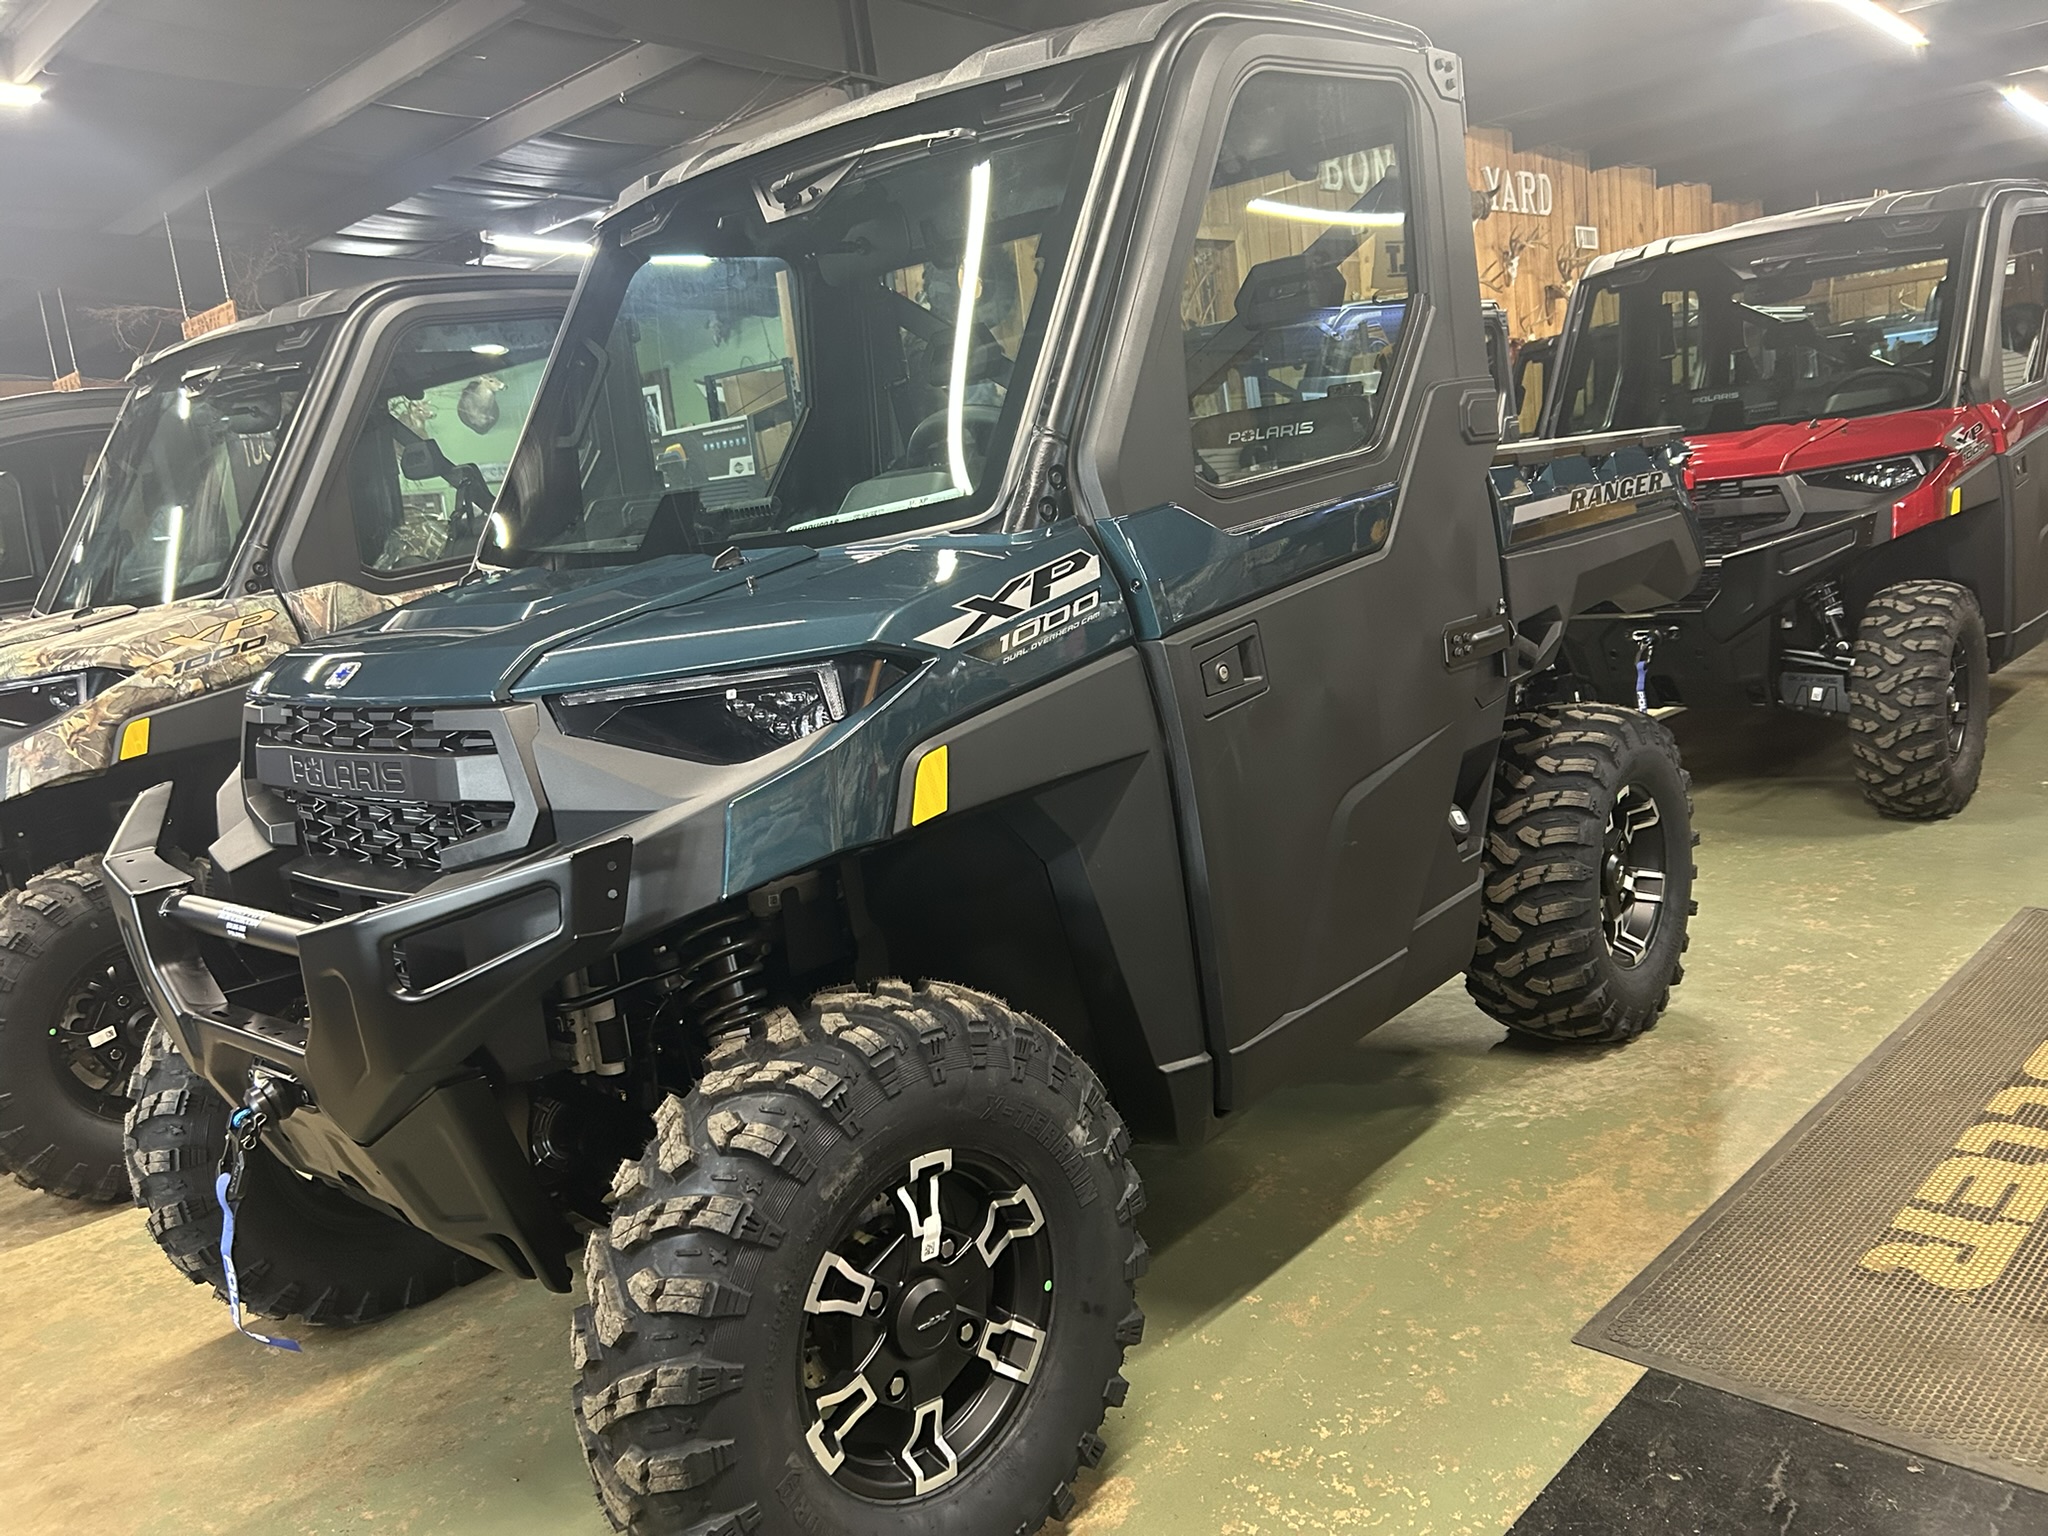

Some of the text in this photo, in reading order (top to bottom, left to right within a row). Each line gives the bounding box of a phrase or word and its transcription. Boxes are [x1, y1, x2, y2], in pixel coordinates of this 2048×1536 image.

[1480, 165, 1554, 217] YARD
[1692, 391, 1740, 405] POLARIS
[1227, 421, 1315, 445] POLARIS
[1951, 421, 1985, 450] XP
[1567, 470, 1664, 515] RANGER
[949, 549, 1097, 648] XP
[1000, 590, 1100, 654] 1000
[149, 608, 280, 668] XP
[173, 634, 268, 677] 1000
[1002, 611, 1101, 665] DUAL OVERHEAD CAM
[289, 754, 408, 794] POLARIS
[979, 1094, 1099, 1209] X-TERRAIN
